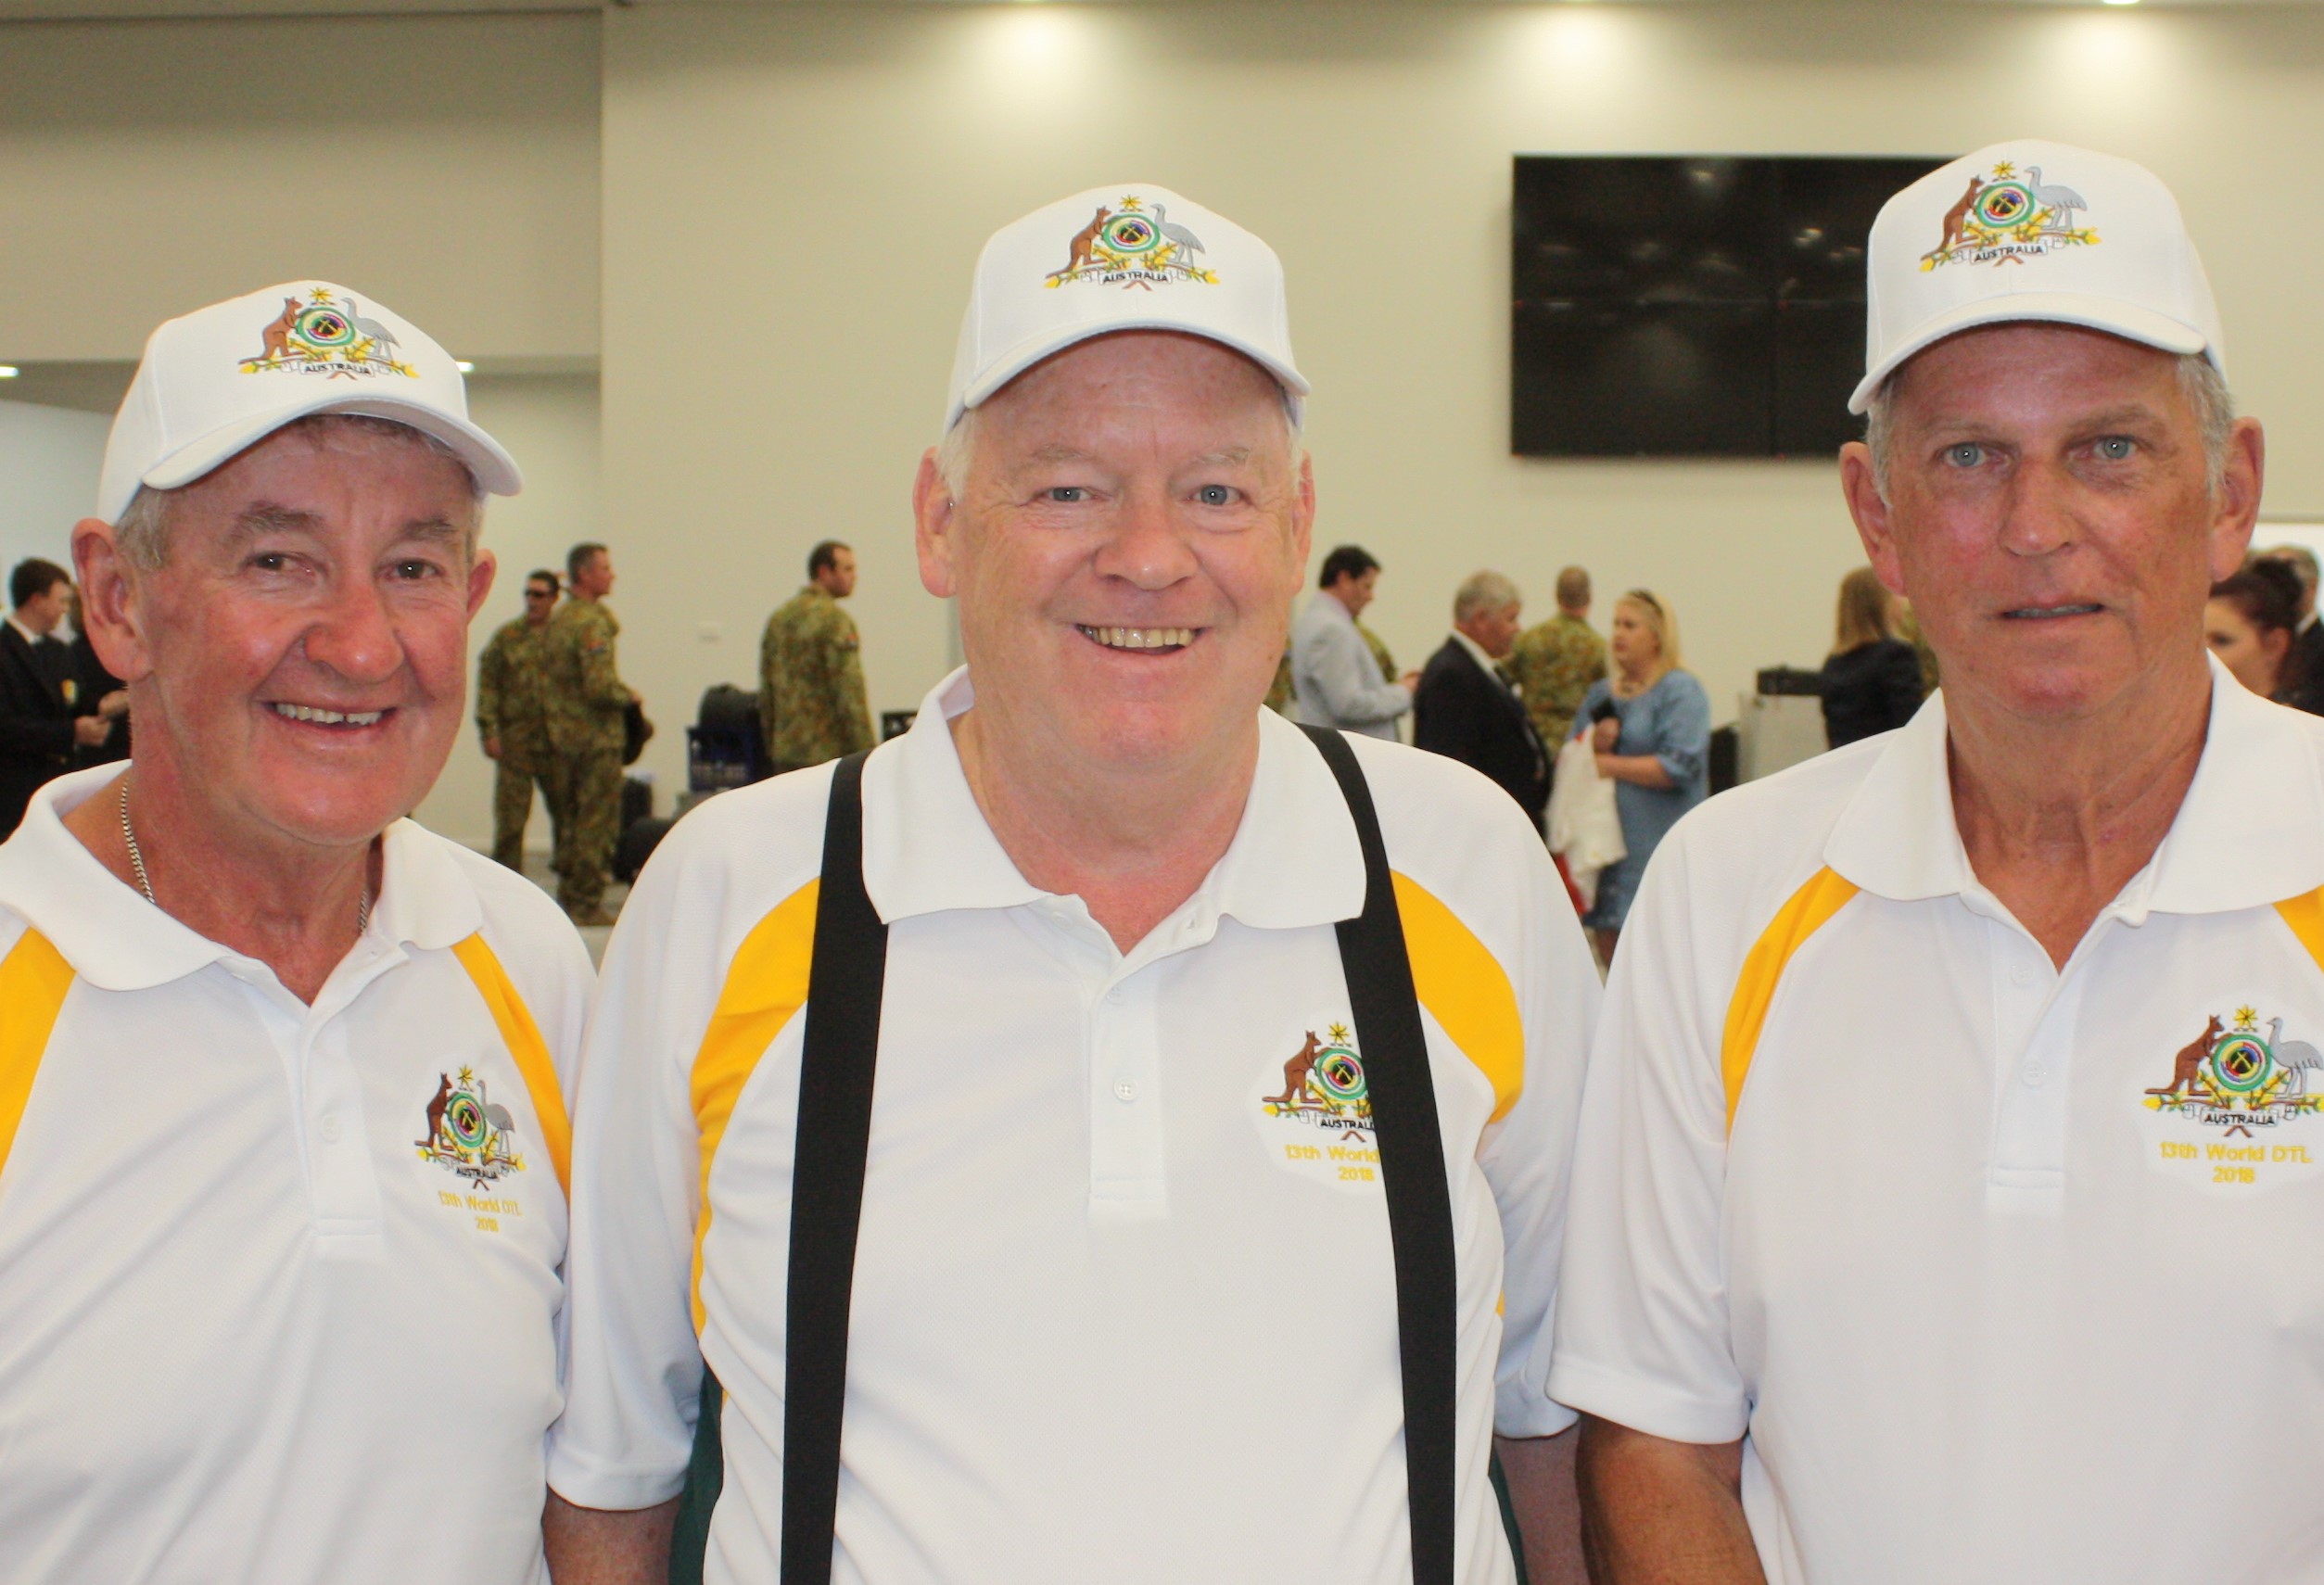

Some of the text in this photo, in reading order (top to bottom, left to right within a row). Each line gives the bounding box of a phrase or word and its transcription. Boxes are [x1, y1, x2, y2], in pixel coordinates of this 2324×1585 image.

[1974, 245, 2043, 262] AUSTRALIA
[1103, 270, 1169, 283] AUSTRALIA
[304, 362, 372, 374] AUSTRALIA
[1320, 1118, 1376, 1130] AUSTRALI
[2204, 1113, 2275, 1125] AUSTRALIA
[1285, 1144, 1380, 1163] 13th World
[2160, 1141, 2314, 1163] 13th World DTL
[1338, 1165, 1376, 1182] 2018
[2213, 1166, 2255, 1184] 2018
